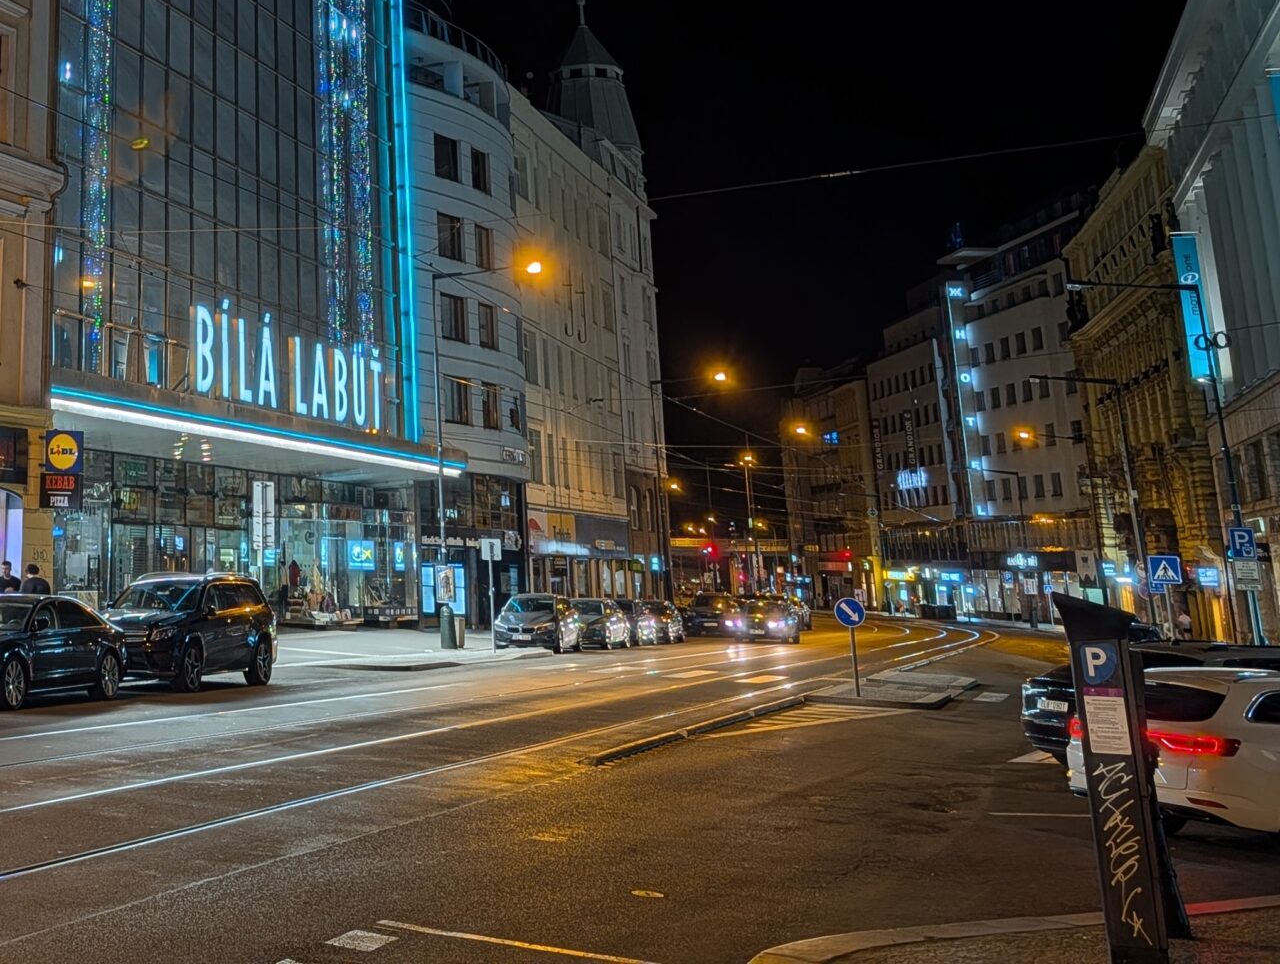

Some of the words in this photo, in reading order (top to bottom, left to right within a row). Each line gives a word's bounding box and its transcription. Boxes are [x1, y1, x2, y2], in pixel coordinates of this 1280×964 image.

[196, 298, 278, 409] BÍLÁ
[294, 336, 382, 430] LABUŤ
[955, 329, 986, 516] HOTEL
[46, 475, 75, 490] KEBAB
[49, 496, 69, 507] PIZZA
[1233, 531, 1249, 550] P
[1084, 646, 1107, 677] P
